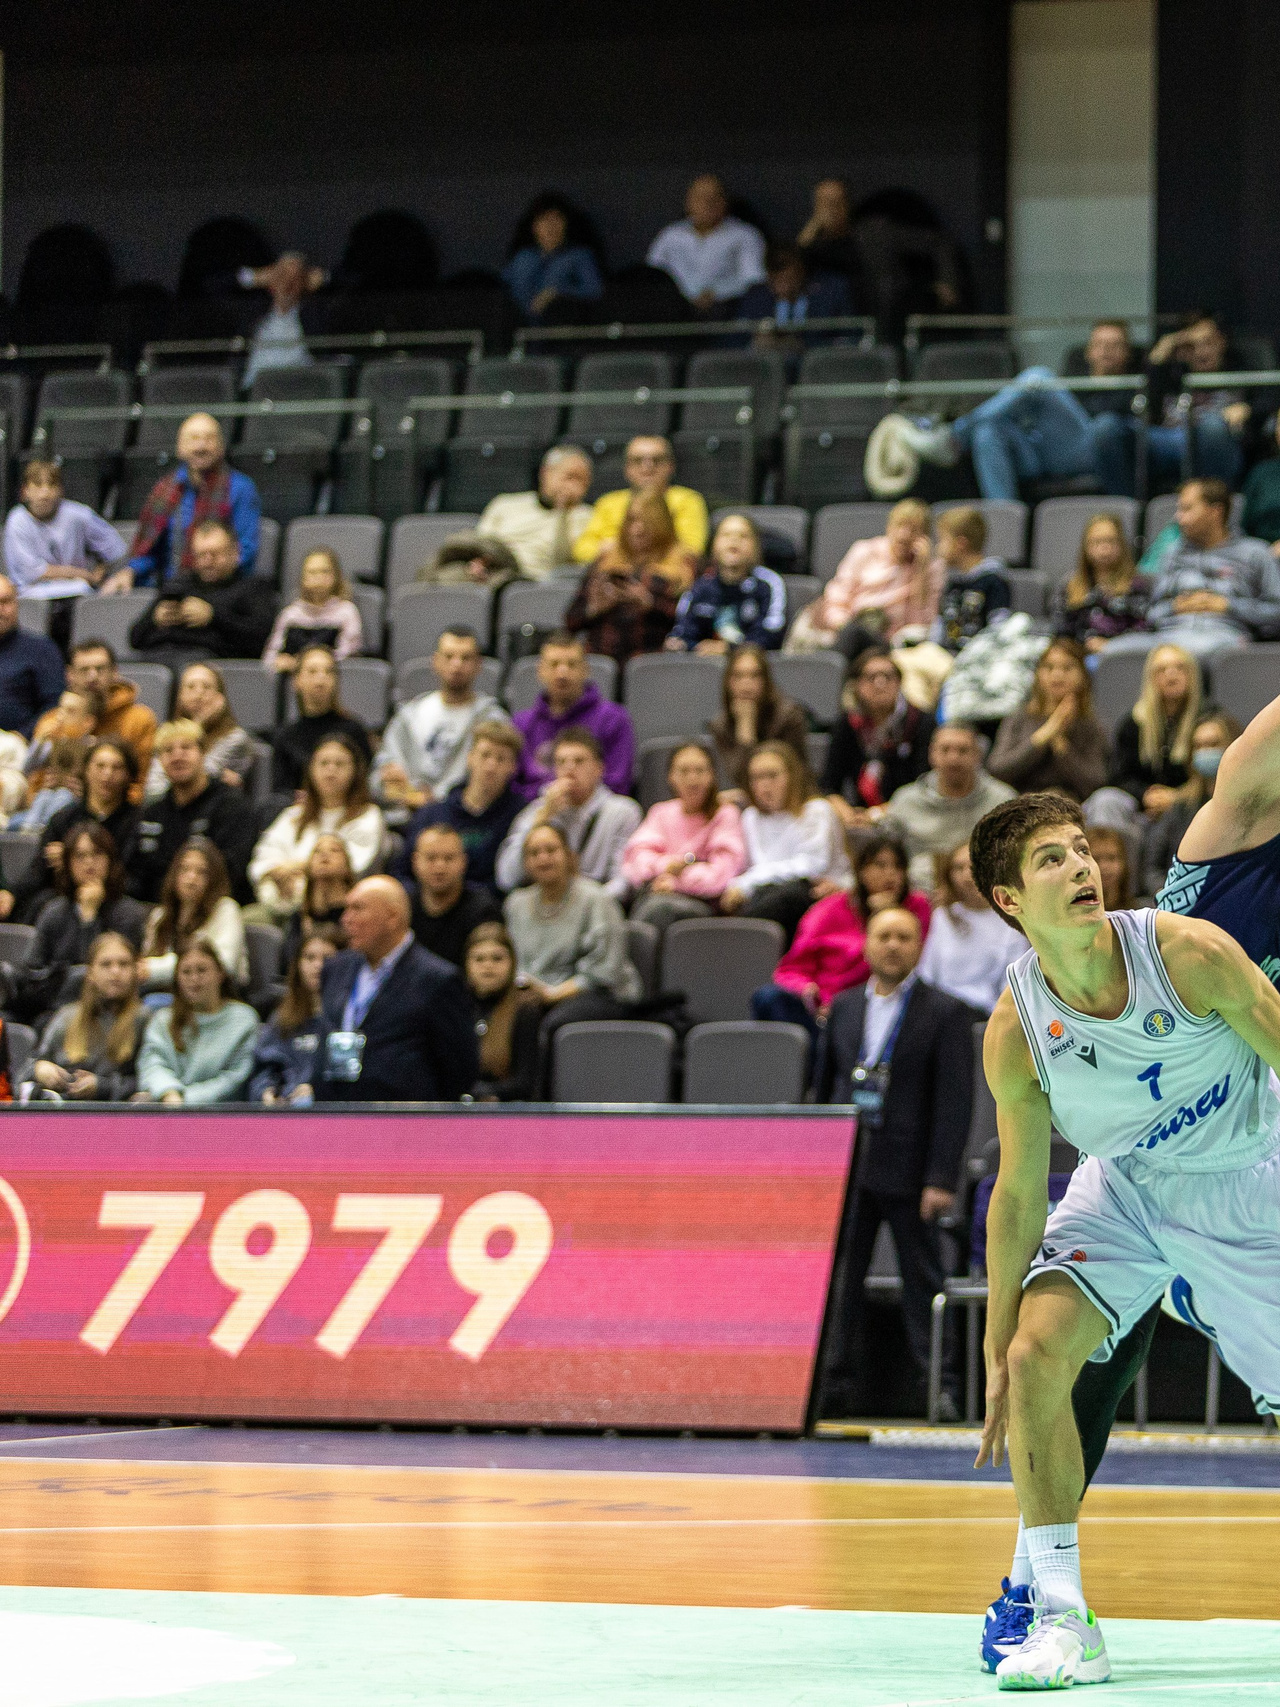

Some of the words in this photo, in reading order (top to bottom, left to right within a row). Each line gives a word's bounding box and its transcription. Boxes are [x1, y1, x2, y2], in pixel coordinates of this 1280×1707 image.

[1050, 1037, 1075, 1057] ENISEY
[1137, 1062, 1163, 1101] 7
[79, 1188, 554, 1362] 7979
